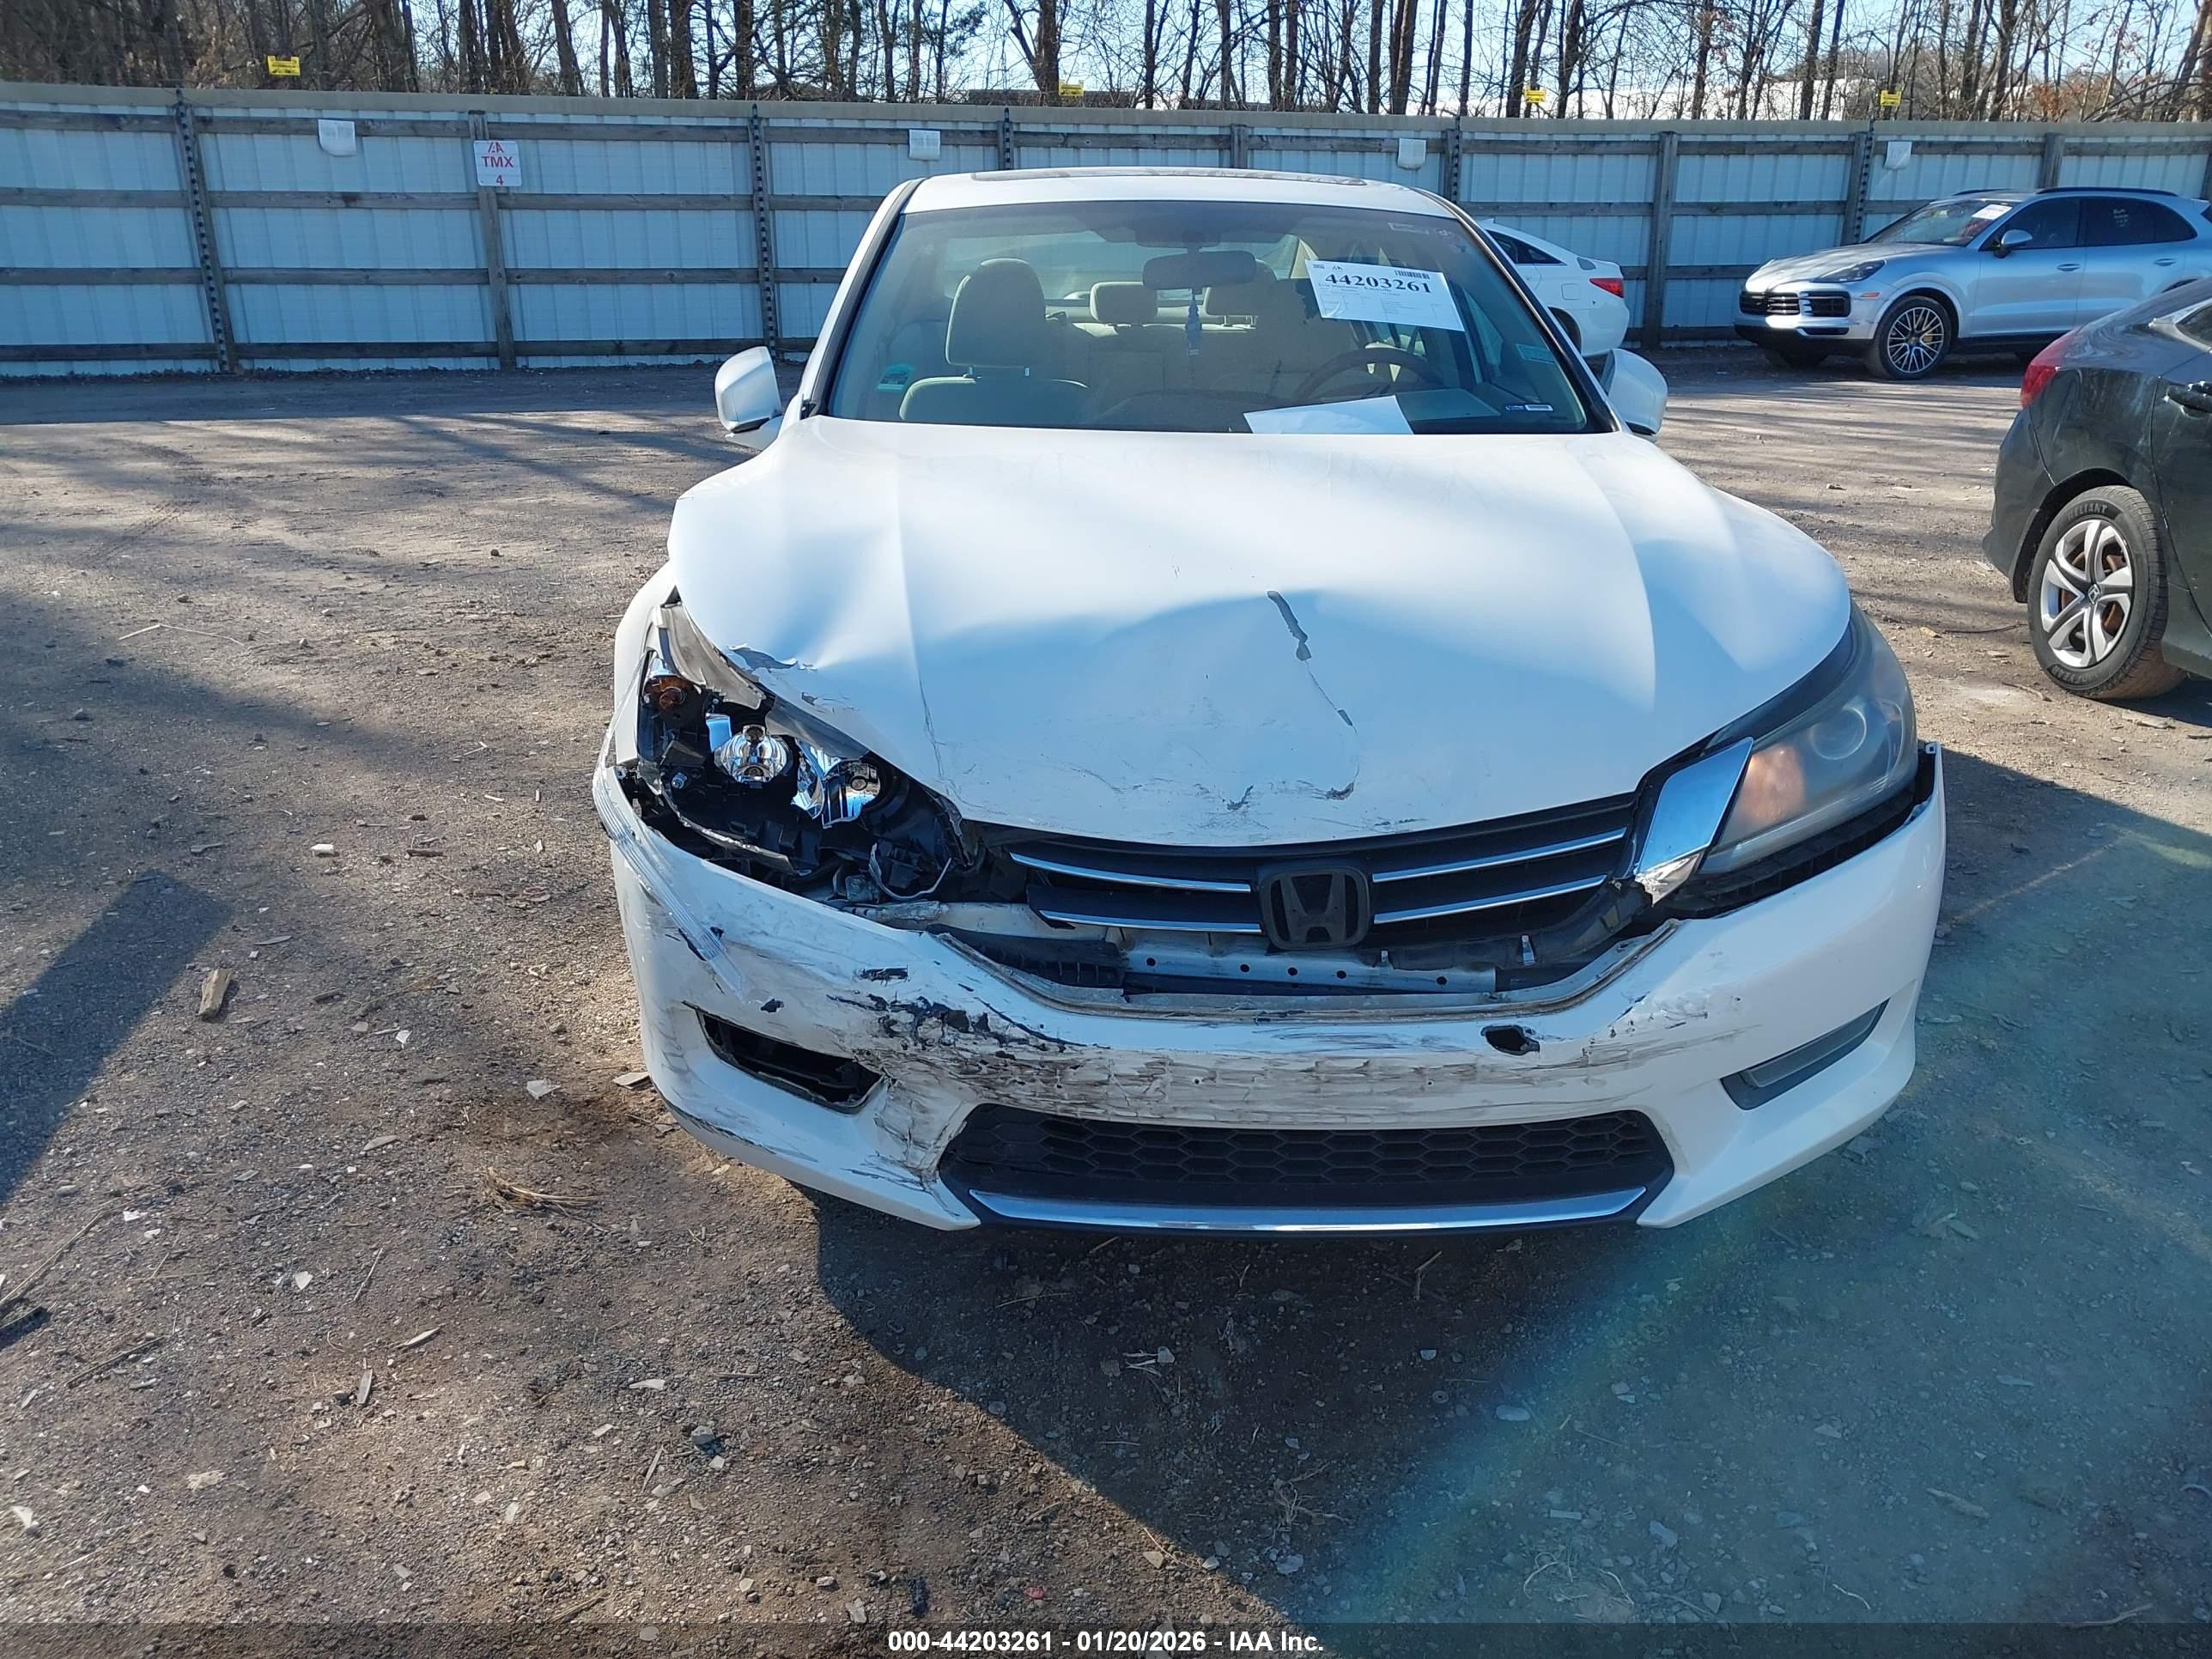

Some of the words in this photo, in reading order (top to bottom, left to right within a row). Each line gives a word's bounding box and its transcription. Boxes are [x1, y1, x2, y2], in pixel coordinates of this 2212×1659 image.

[481, 155, 514, 167] TMX
[495, 174, 504, 185] 4
[1325, 274, 1431, 294] 44203261
